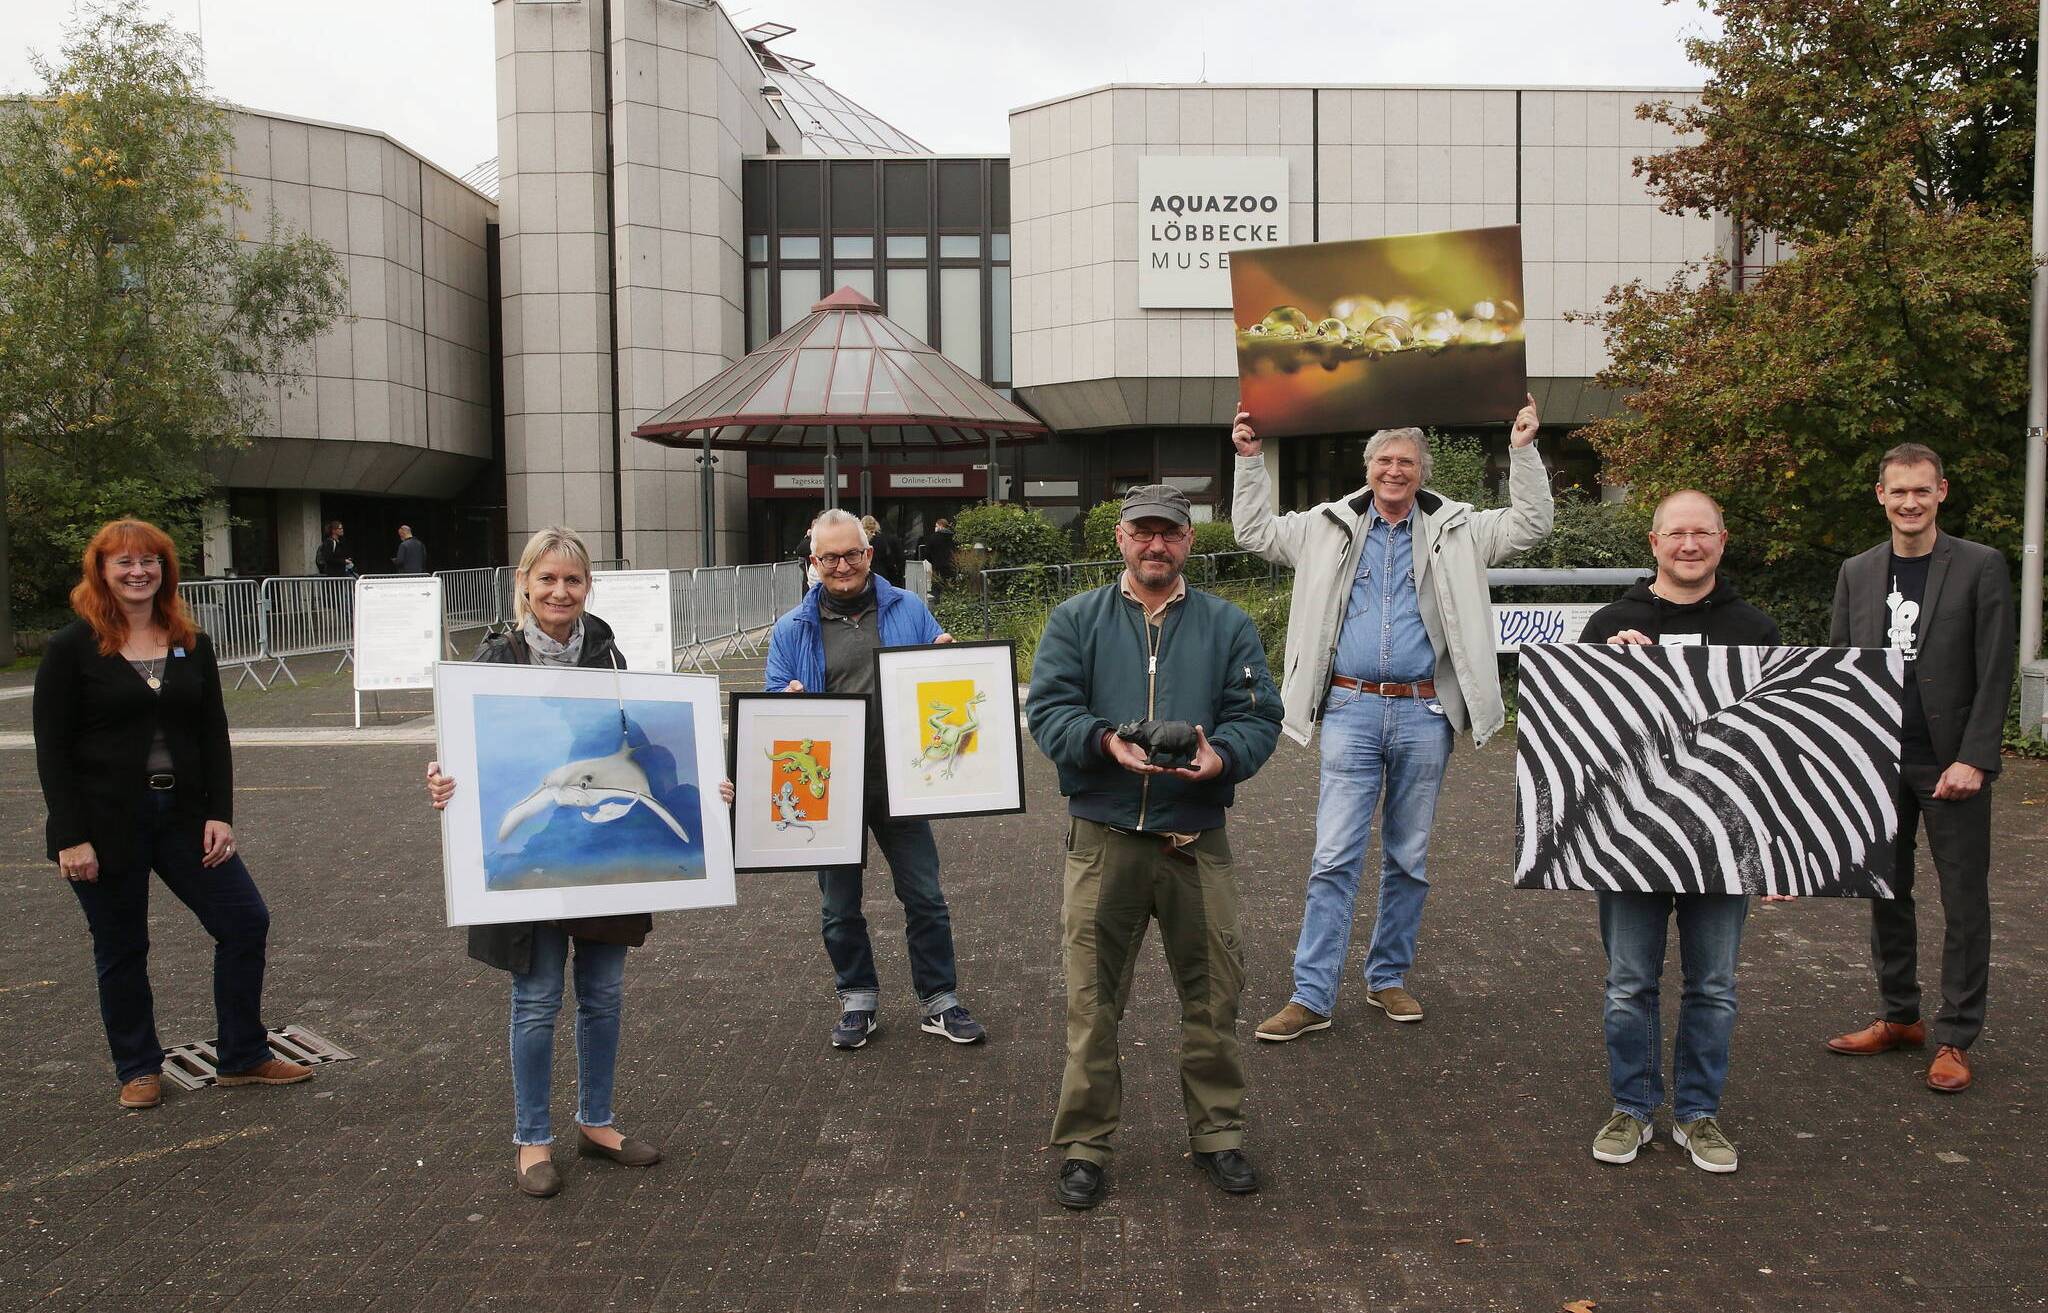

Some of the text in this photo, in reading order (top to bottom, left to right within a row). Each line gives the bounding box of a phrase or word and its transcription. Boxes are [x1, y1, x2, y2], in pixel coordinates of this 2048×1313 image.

[1150, 195, 1277, 217] AQUAZOO
[1152, 221, 1277, 241] LÖBBECKE
[1152, 252, 1229, 269] MUSE
[792, 478, 825, 486] Tageskas
[901, 476, 952, 484] Online-Tickets
